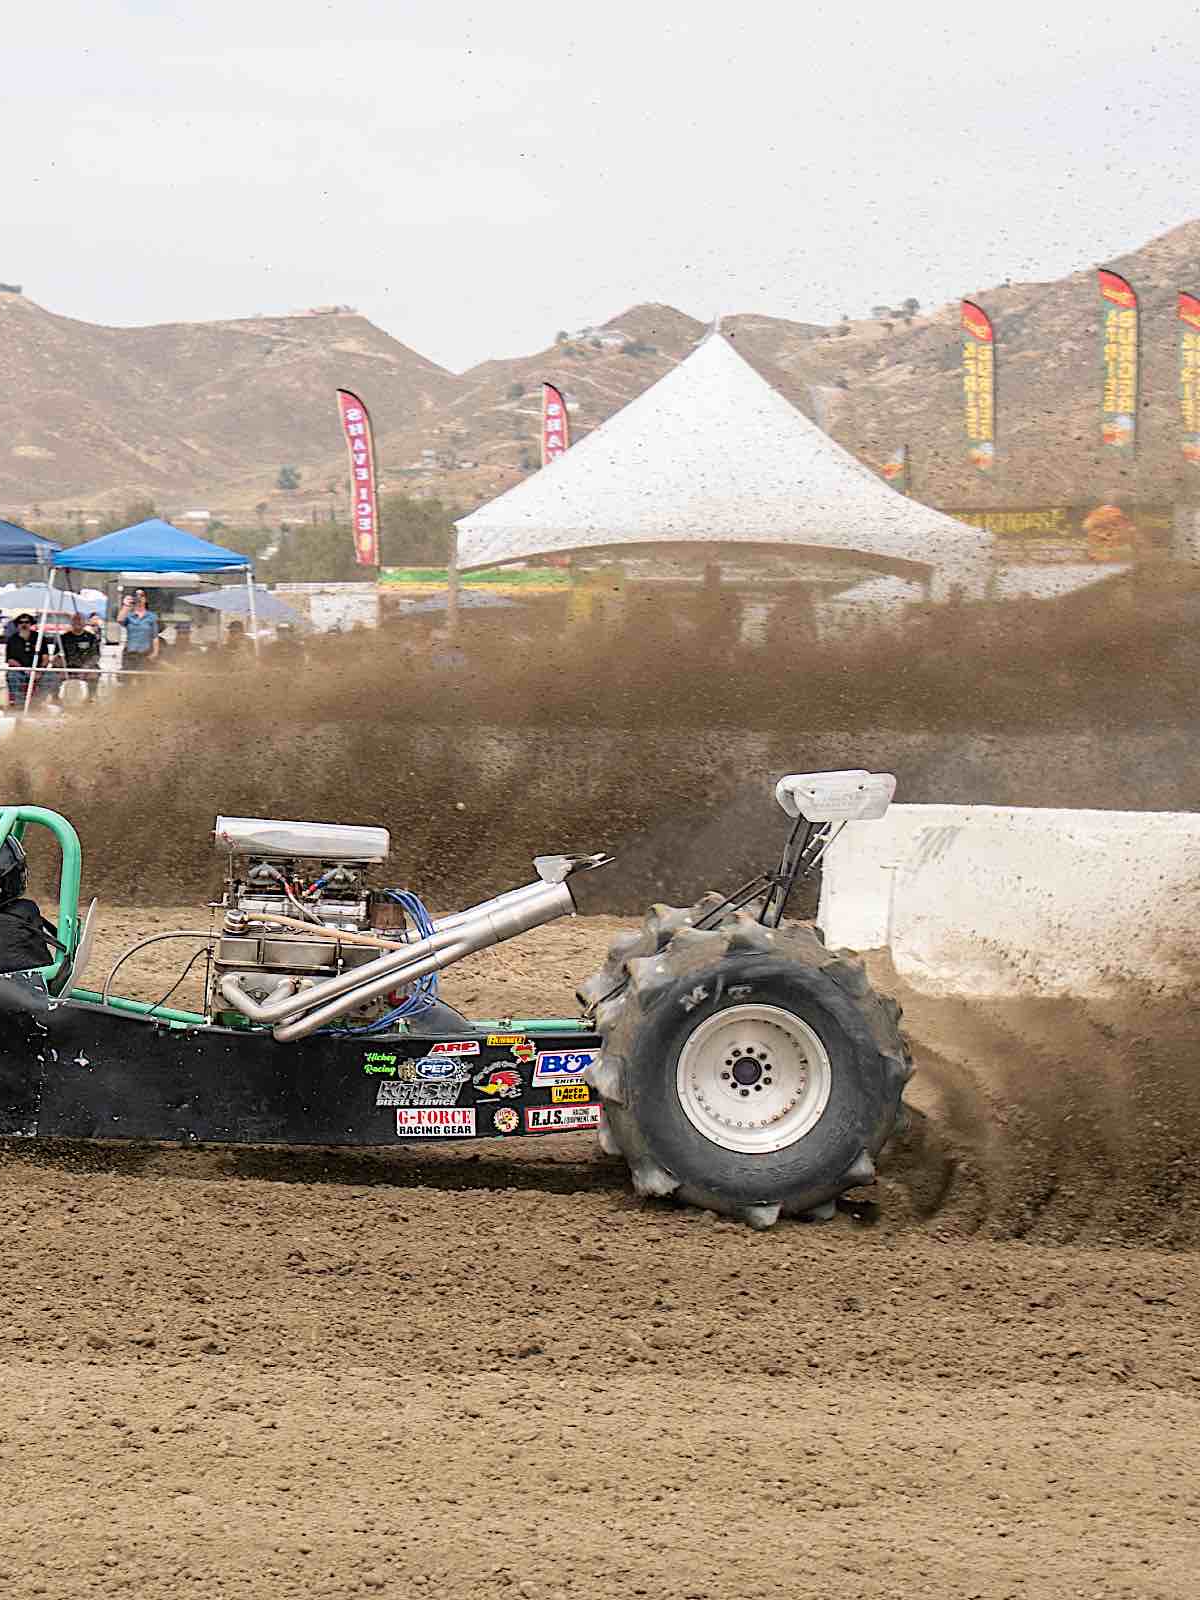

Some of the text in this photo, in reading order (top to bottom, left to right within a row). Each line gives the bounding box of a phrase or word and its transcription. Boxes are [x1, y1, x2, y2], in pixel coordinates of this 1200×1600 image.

[432, 1042, 476, 1052] ARP
[364, 1064, 396, 1077] Racing
[421, 1064, 453, 1073] PEP
[398, 1109, 472, 1125] G-FORCE
[531, 1110, 563, 1127] R.J.S.
[399, 1125, 472, 1135] RACING GEAR
